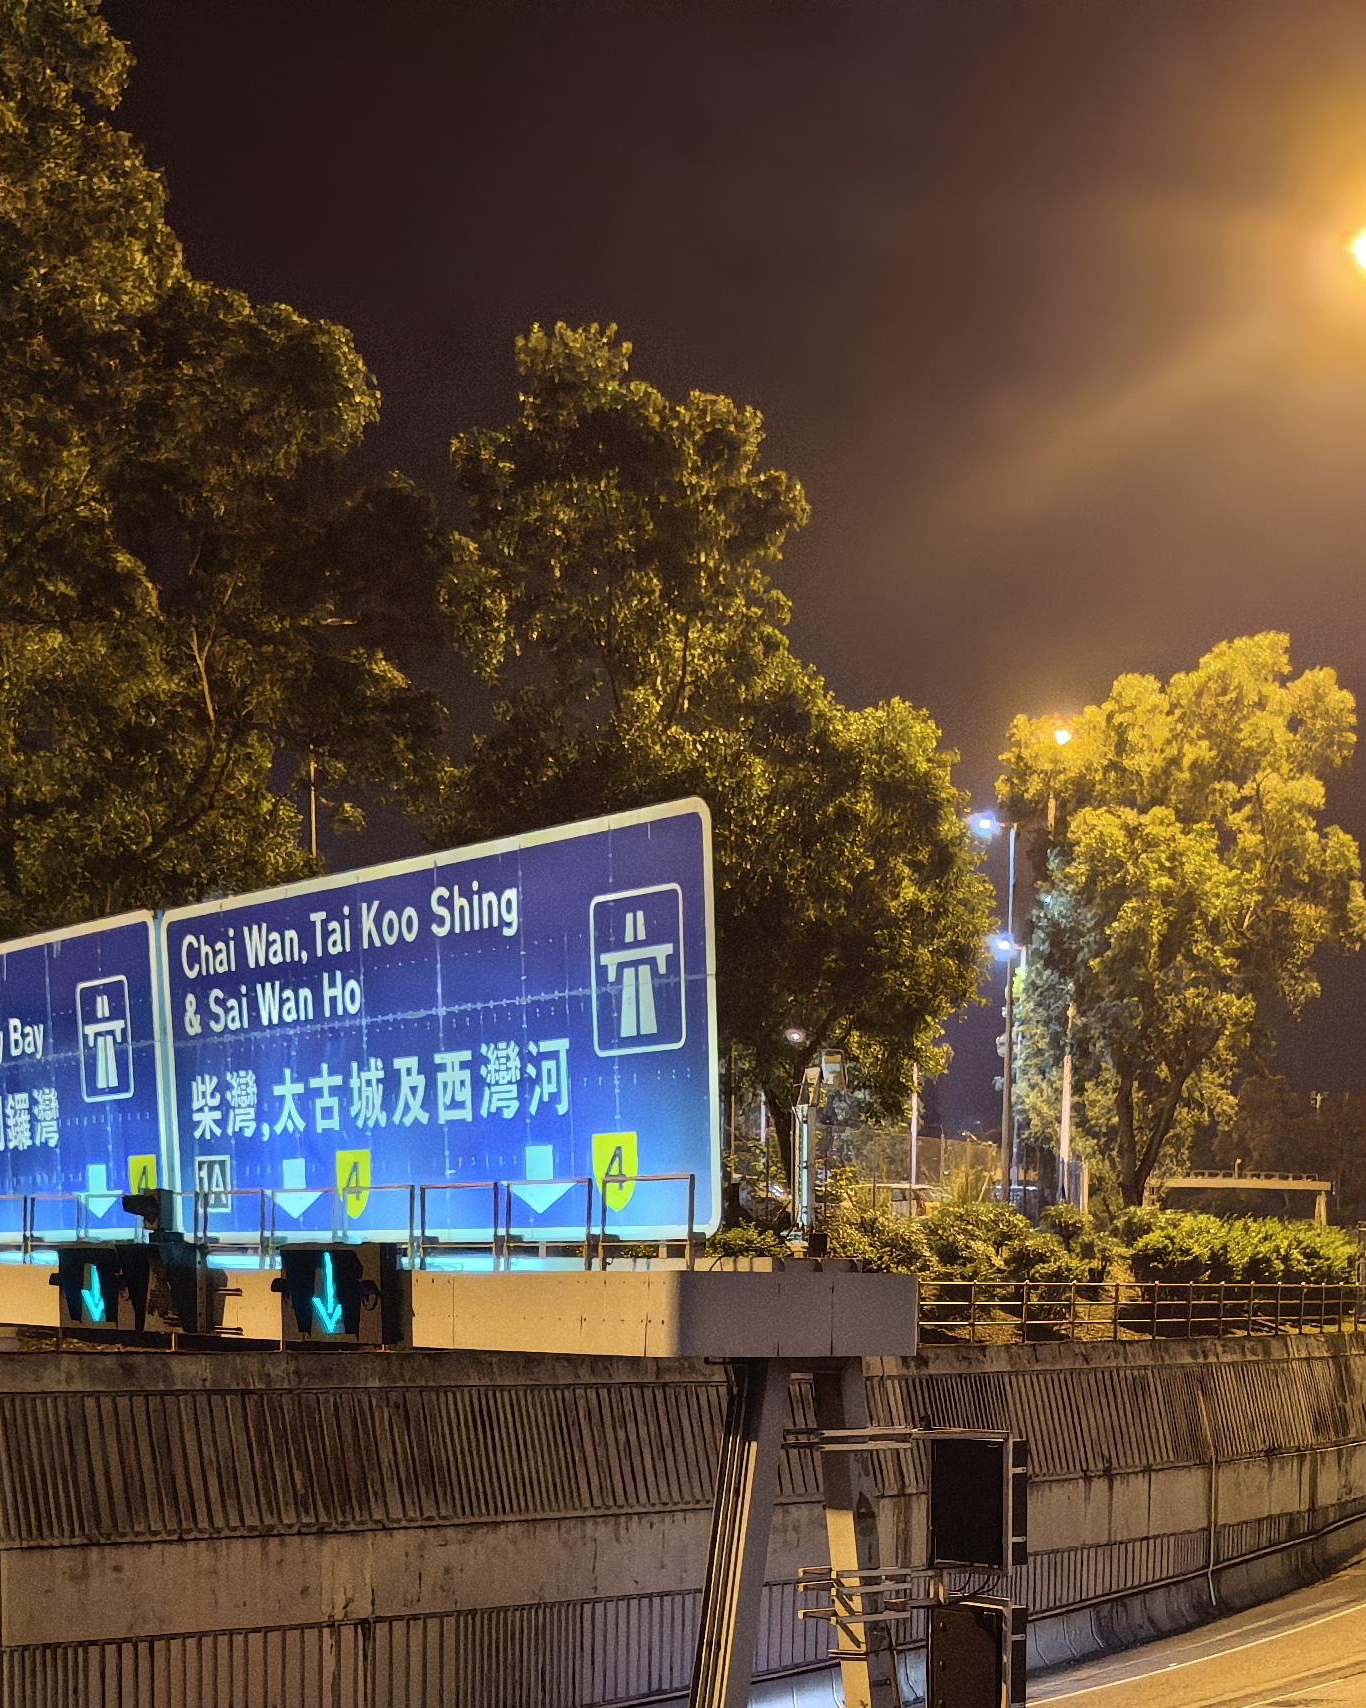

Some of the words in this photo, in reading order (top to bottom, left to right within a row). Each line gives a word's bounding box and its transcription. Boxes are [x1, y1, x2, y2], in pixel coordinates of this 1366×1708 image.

[181, 928, 236, 979] Chai
[242, 921, 308, 969] Wan,
[309, 905, 351, 958] Tai
[361, 900, 419, 950] Koo
[430, 880, 519, 937] Shing
[184, 993, 202, 1036] &
[208, 984, 249, 1033] Sai
[256, 980, 314, 1027] Wan
[322, 970, 362, 1017] Ho
[8, 1017, 45, 1063] Bay
[198, 1161, 228, 1205] 1A
[347, 1161, 362, 1201] 4
[605, 1145, 627, 1191] 4
